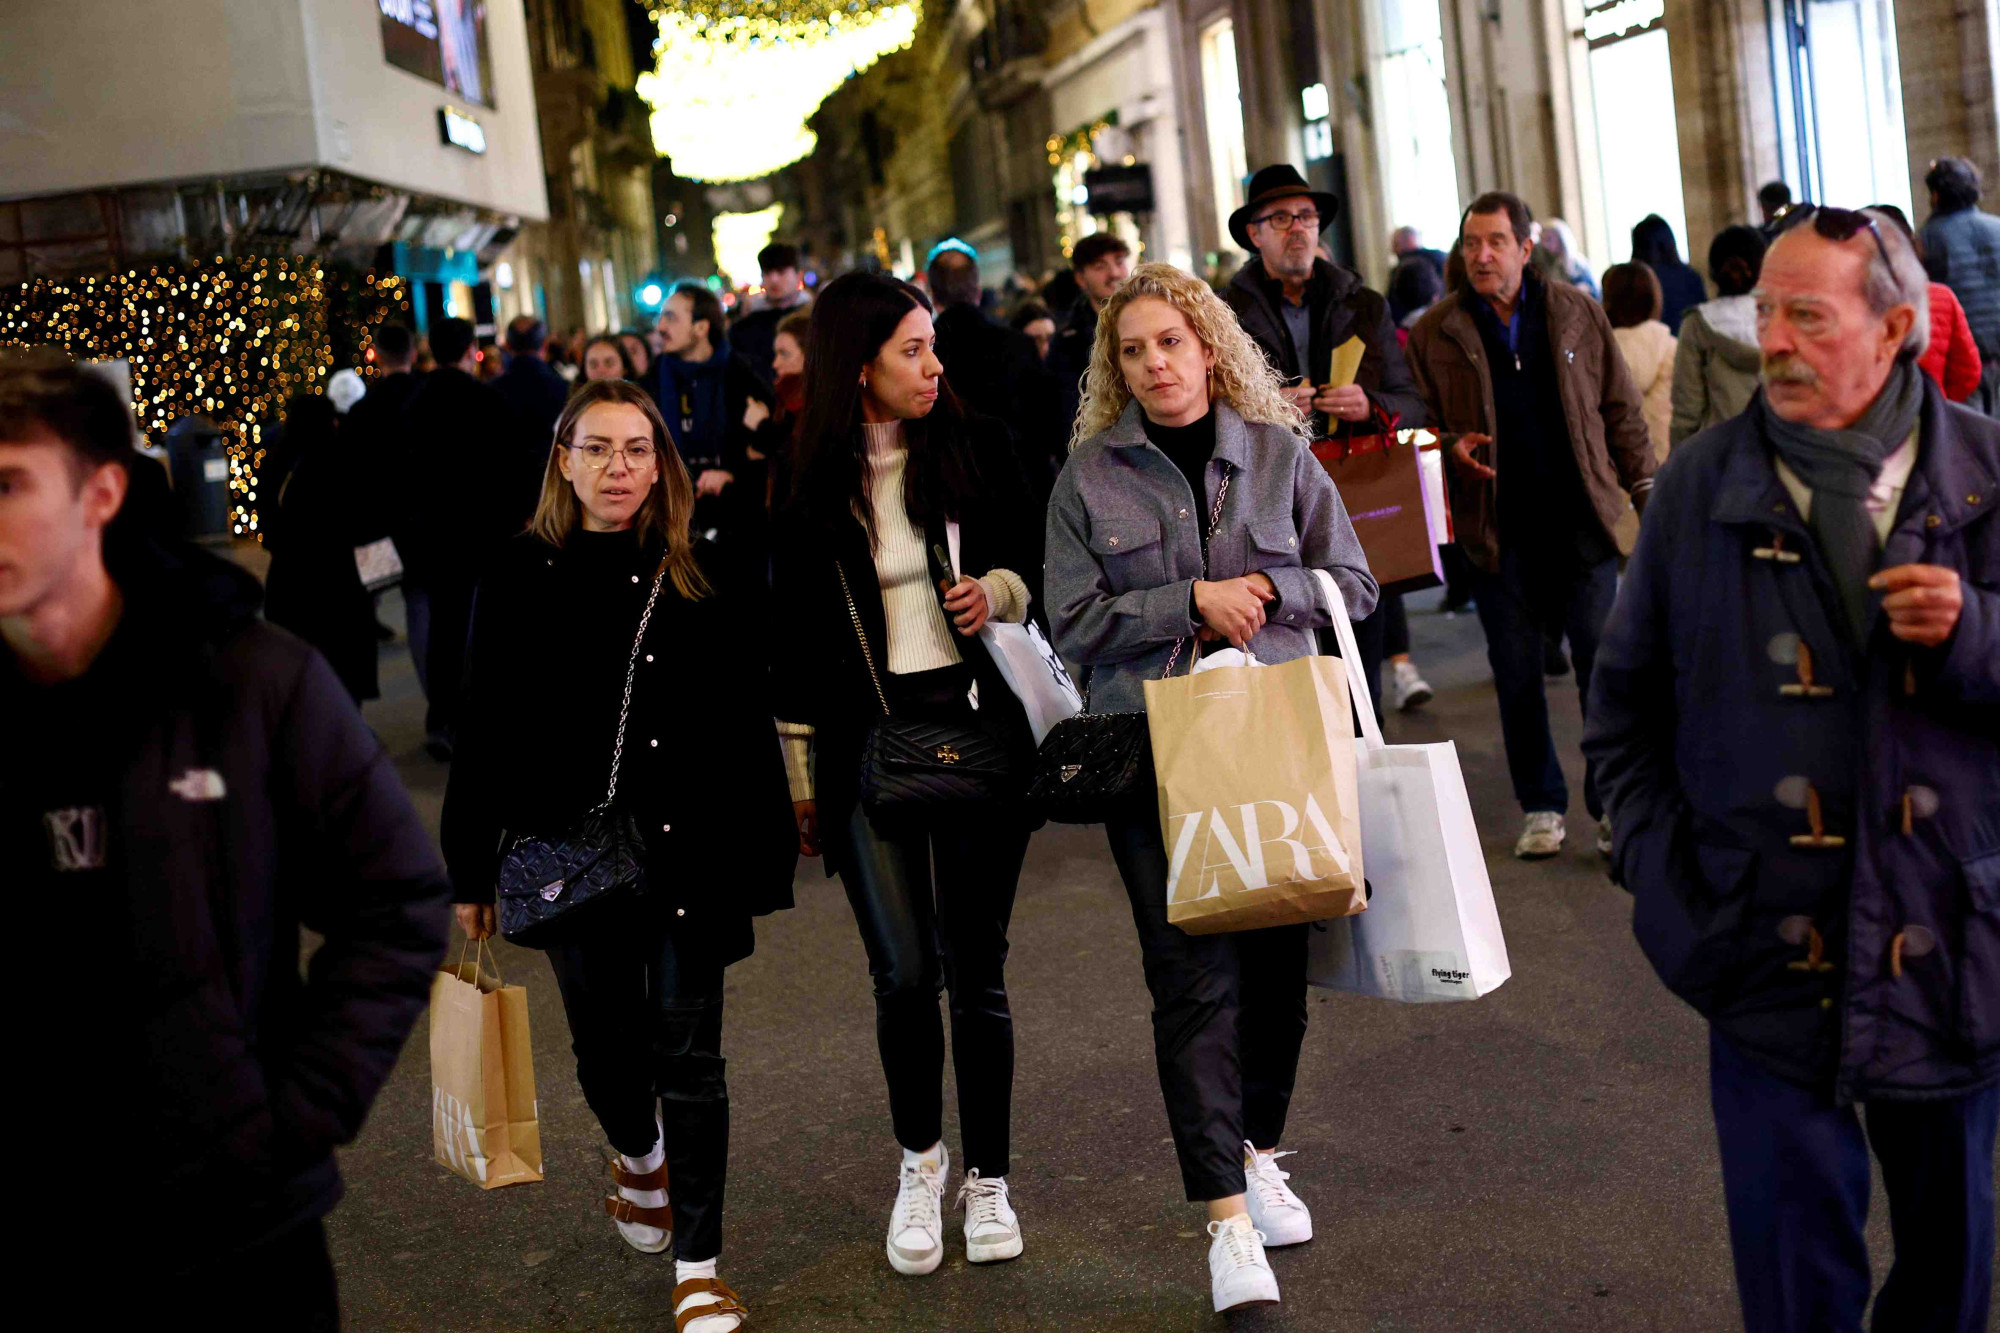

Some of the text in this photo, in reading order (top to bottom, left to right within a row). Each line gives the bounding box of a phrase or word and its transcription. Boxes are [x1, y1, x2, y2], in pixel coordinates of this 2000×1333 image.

[1167, 792, 1351, 906] ZARA
[1431, 968, 1470, 980] flying tiger
